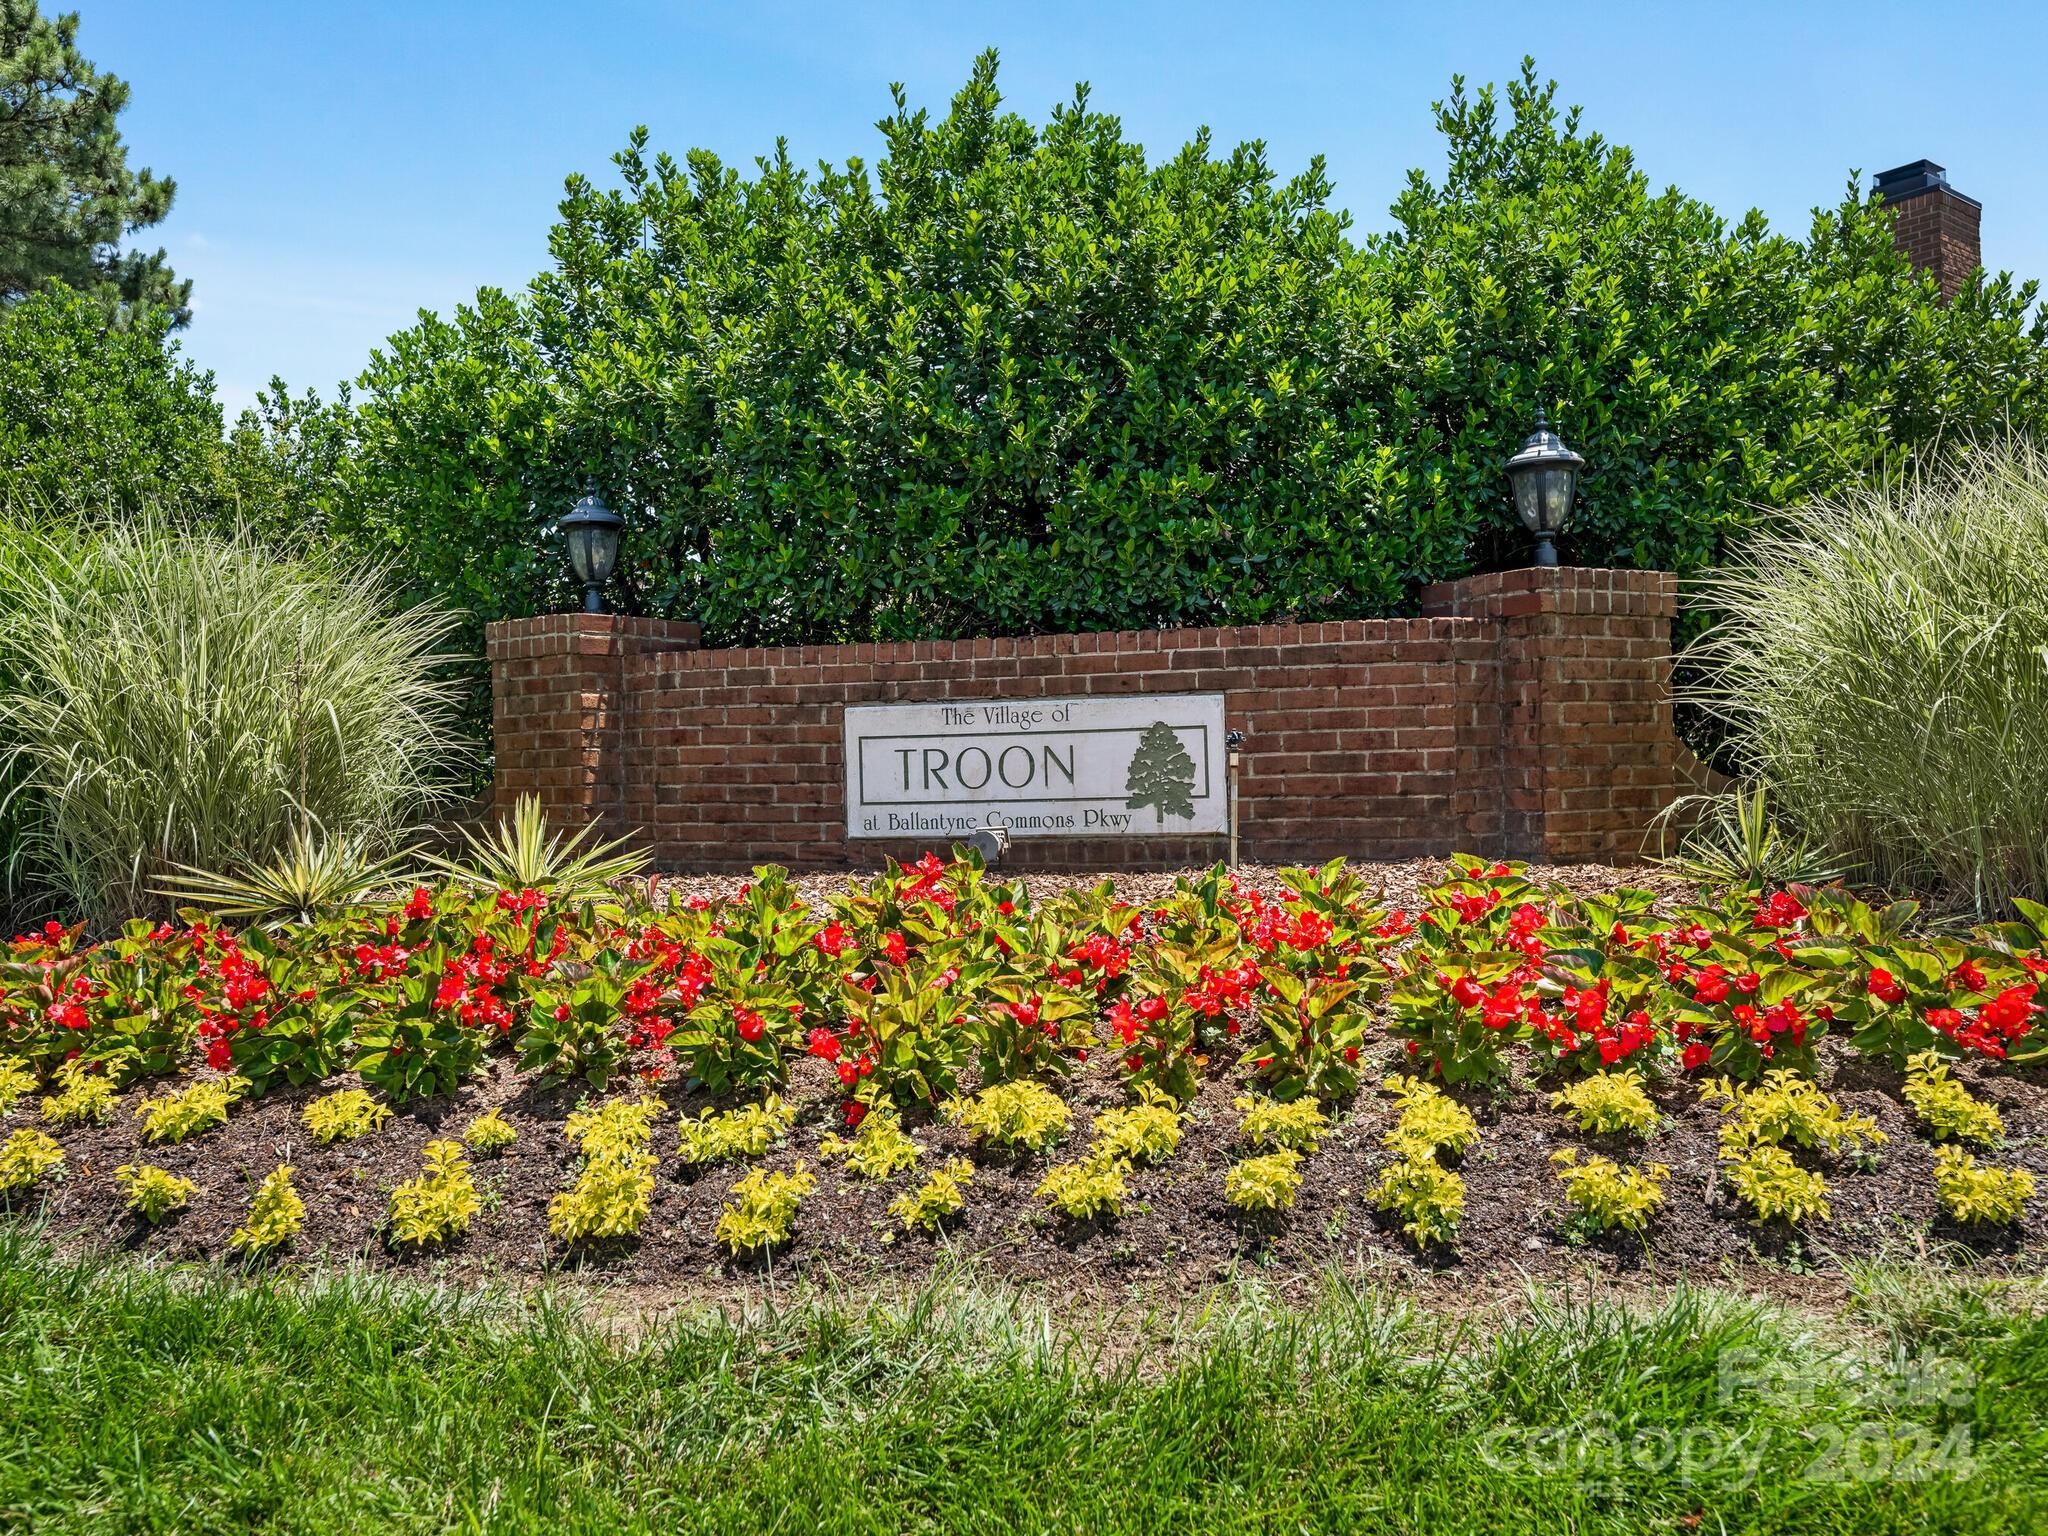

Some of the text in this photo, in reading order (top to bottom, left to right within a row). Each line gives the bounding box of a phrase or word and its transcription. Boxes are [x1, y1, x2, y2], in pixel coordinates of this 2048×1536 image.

[941, 703, 1073, 730] The Village of
[894, 744, 1076, 792] TROON
[863, 808, 1132, 836] at Ballantyne Commons Pkwy
